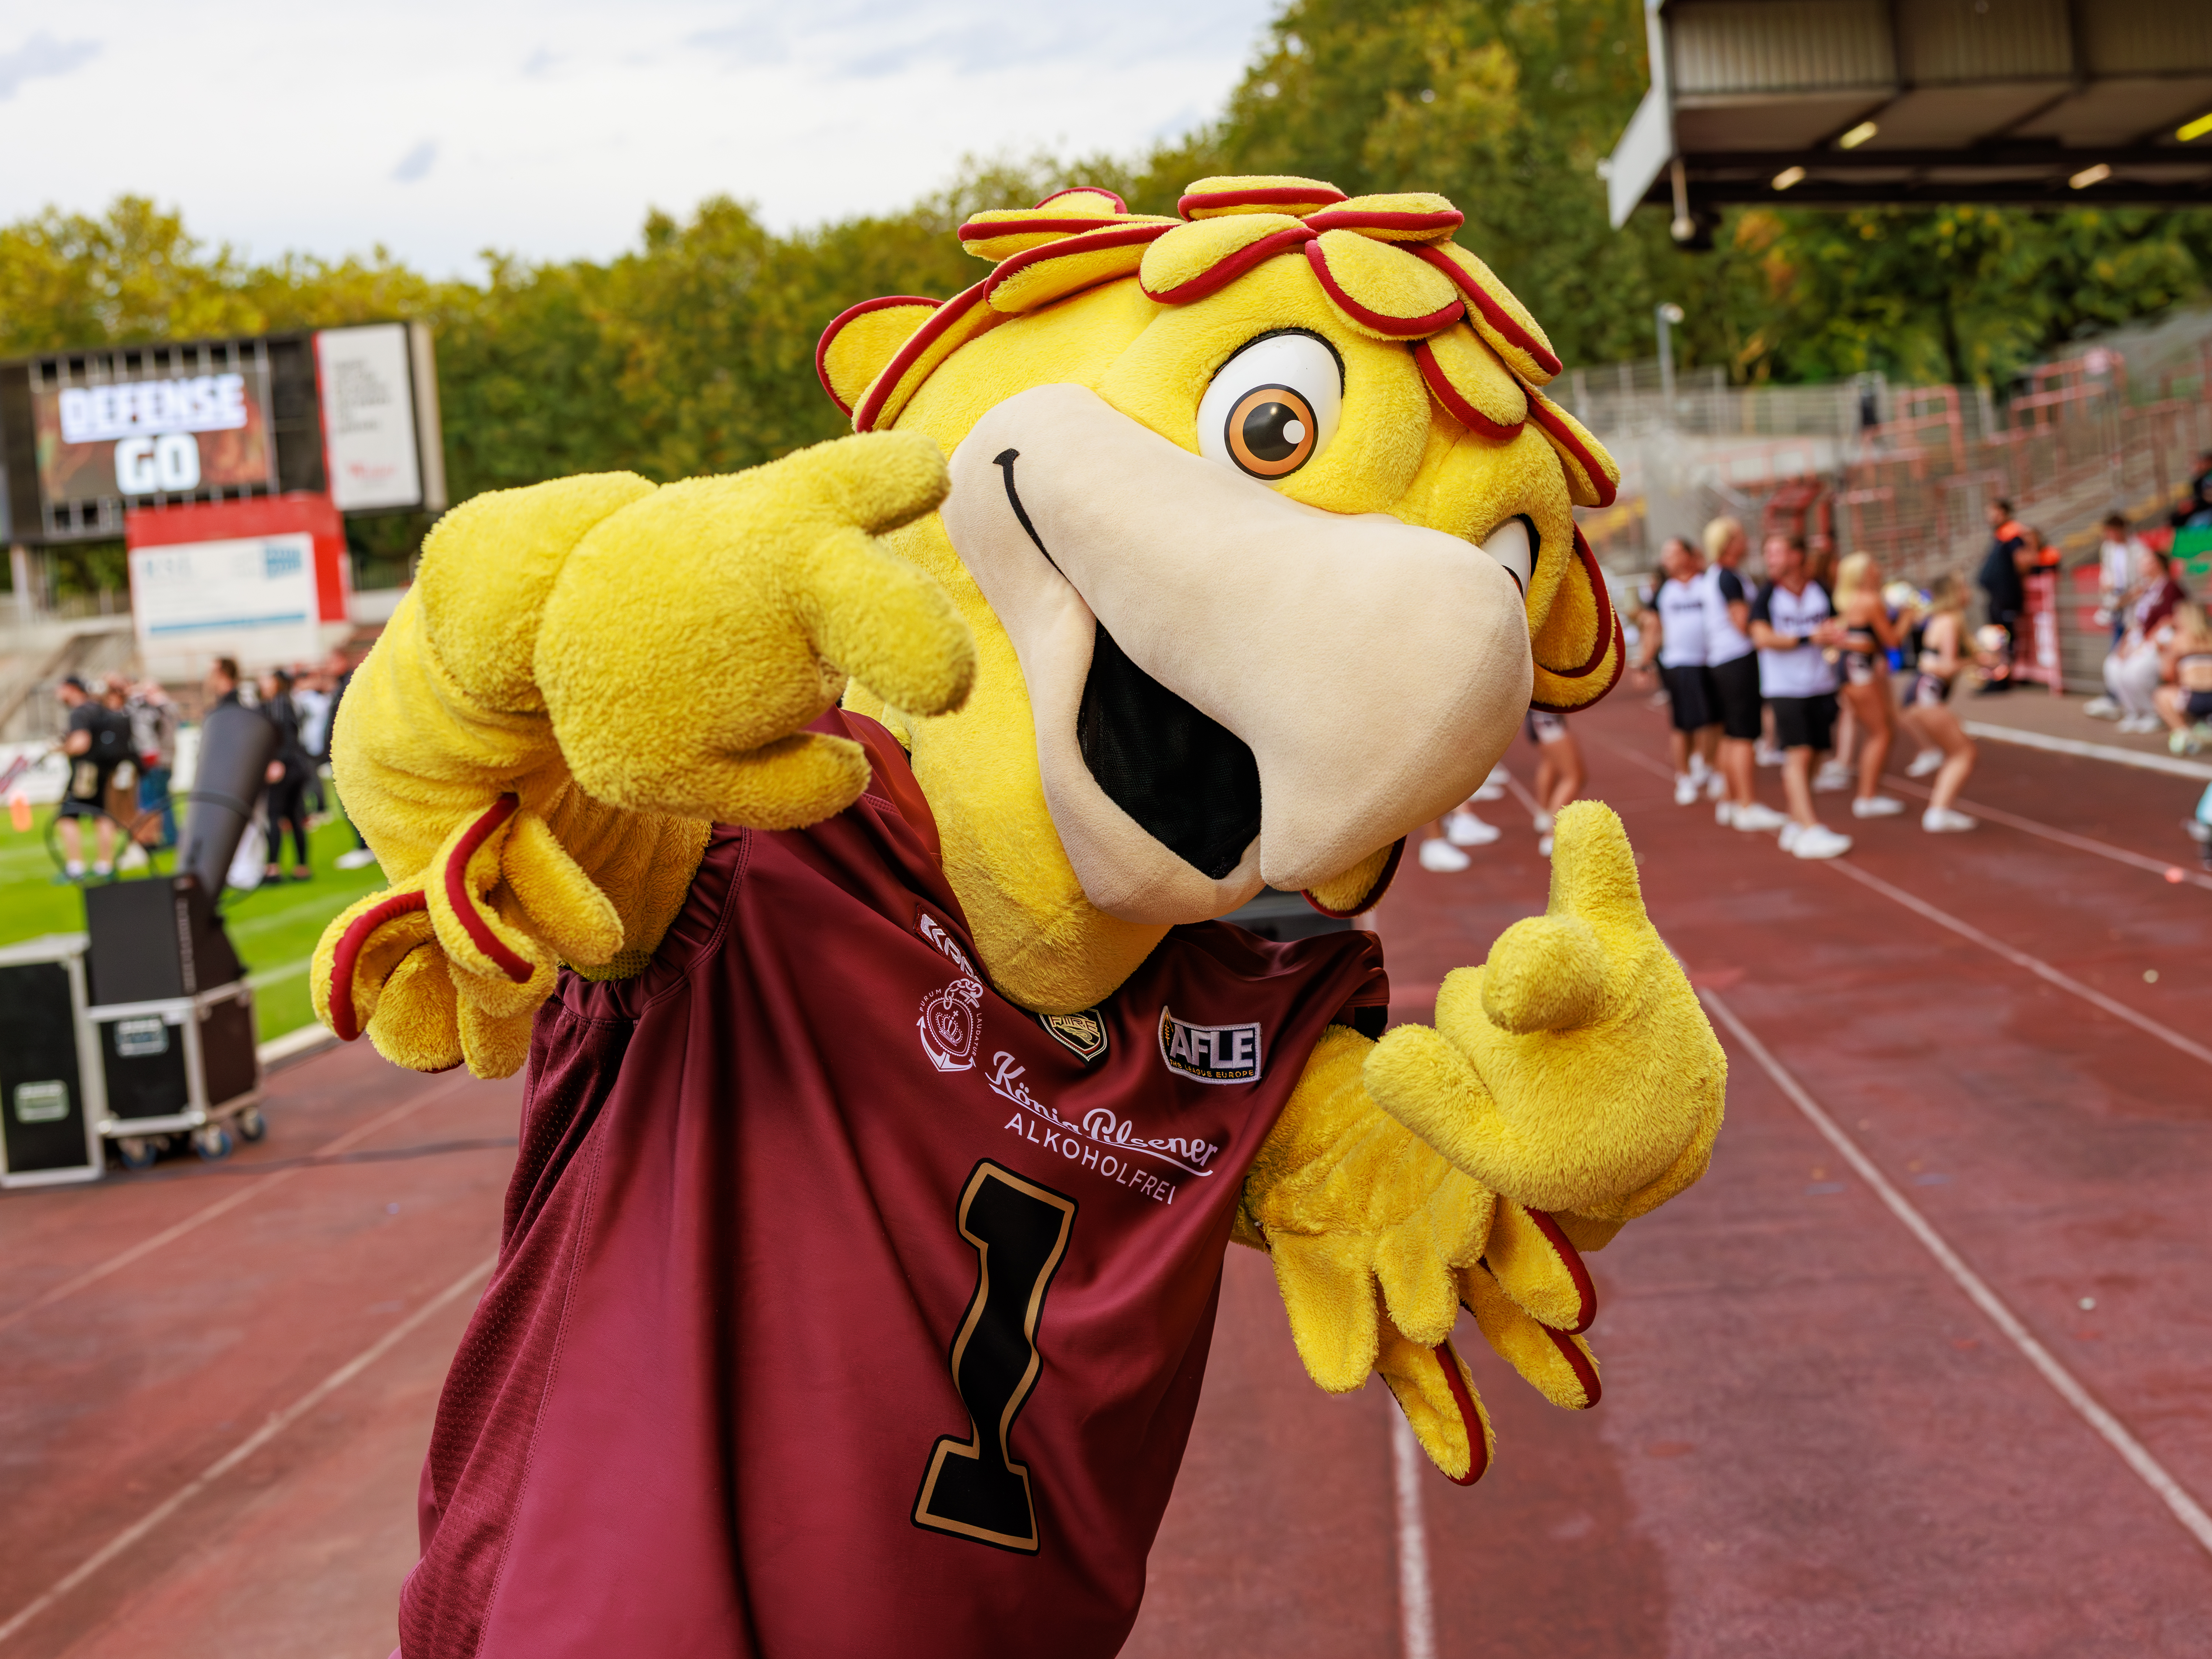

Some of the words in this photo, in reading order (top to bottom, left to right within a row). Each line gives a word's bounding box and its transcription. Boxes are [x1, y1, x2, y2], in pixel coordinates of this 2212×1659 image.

[59, 373, 246, 443] DEFENSE
[115, 433, 200, 494] GO
[919, 989, 941, 1012] PURUM
[1048, 1014, 1100, 1038] FIRE
[971, 1013, 982, 1056] LAUDATUR
[1170, 1024, 1253, 1069] AFLE
[1170, 1059, 1182, 1068] THE
[1185, 1064, 1212, 1077] LEAGUE
[1216, 1070, 1254, 1078] EUROPE
[1004, 1113, 1176, 1205] ALKOHOLFREI
[1082, 1108, 1218, 1168] Pilsener
[910, 1158, 1079, 1557] 1
